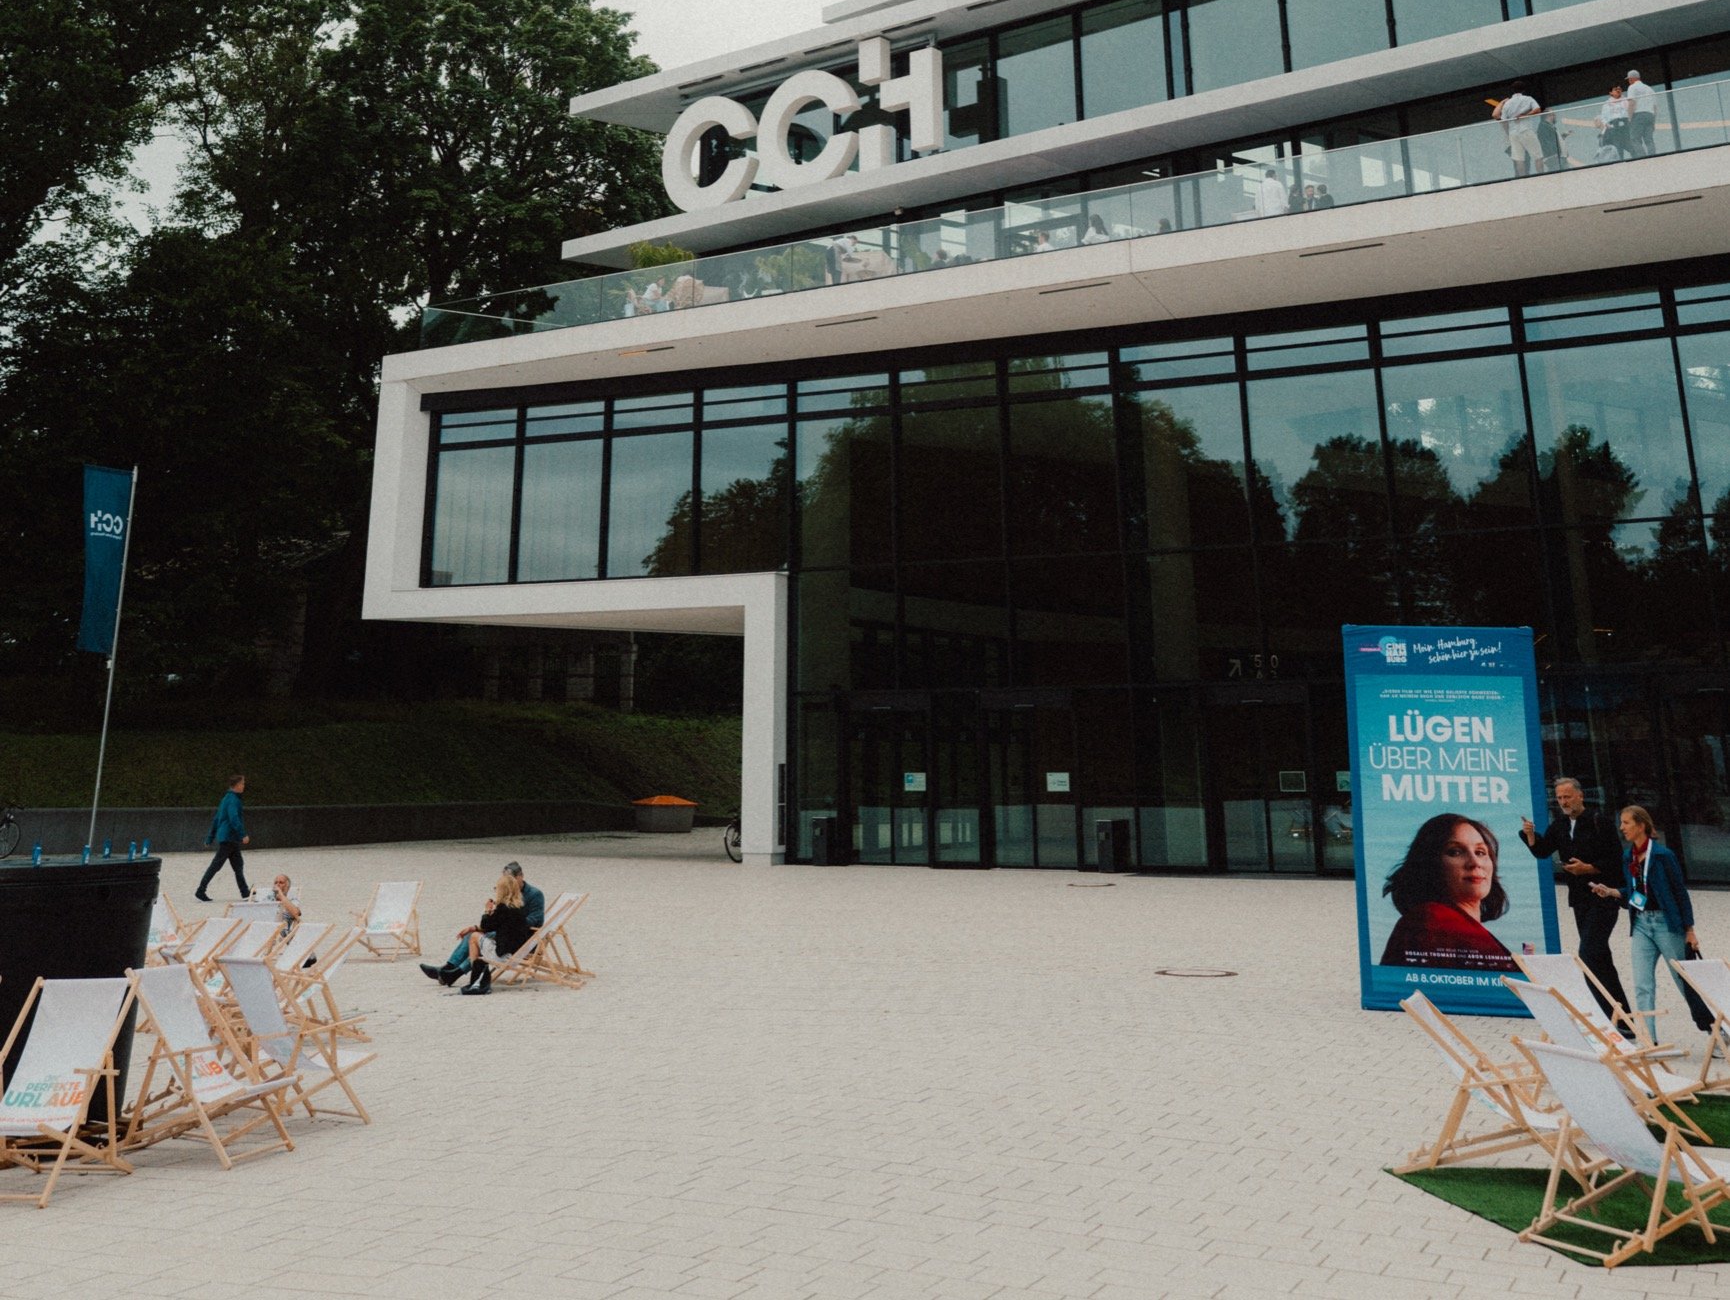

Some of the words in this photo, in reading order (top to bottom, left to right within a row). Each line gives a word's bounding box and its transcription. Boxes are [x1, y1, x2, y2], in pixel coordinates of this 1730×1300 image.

[662, 36, 944, 212] CCH
[1437, 636, 1477, 650] Hamburg.
[1451, 649, 1468, 660] hier
[1480, 641, 1502, 656] sein!
[1389, 709, 1494, 743] LÜGEN
[1369, 742, 1431, 770] ÜBER
[1439, 747, 1518, 772] MEINE
[1382, 774, 1511, 804] MUTTER
[1405, 973, 1419, 982] AB
[1421, 974, 1429, 983] 8.
[1430, 974, 1474, 986] OKTOBER
[1476, 977, 1489, 986] IM
